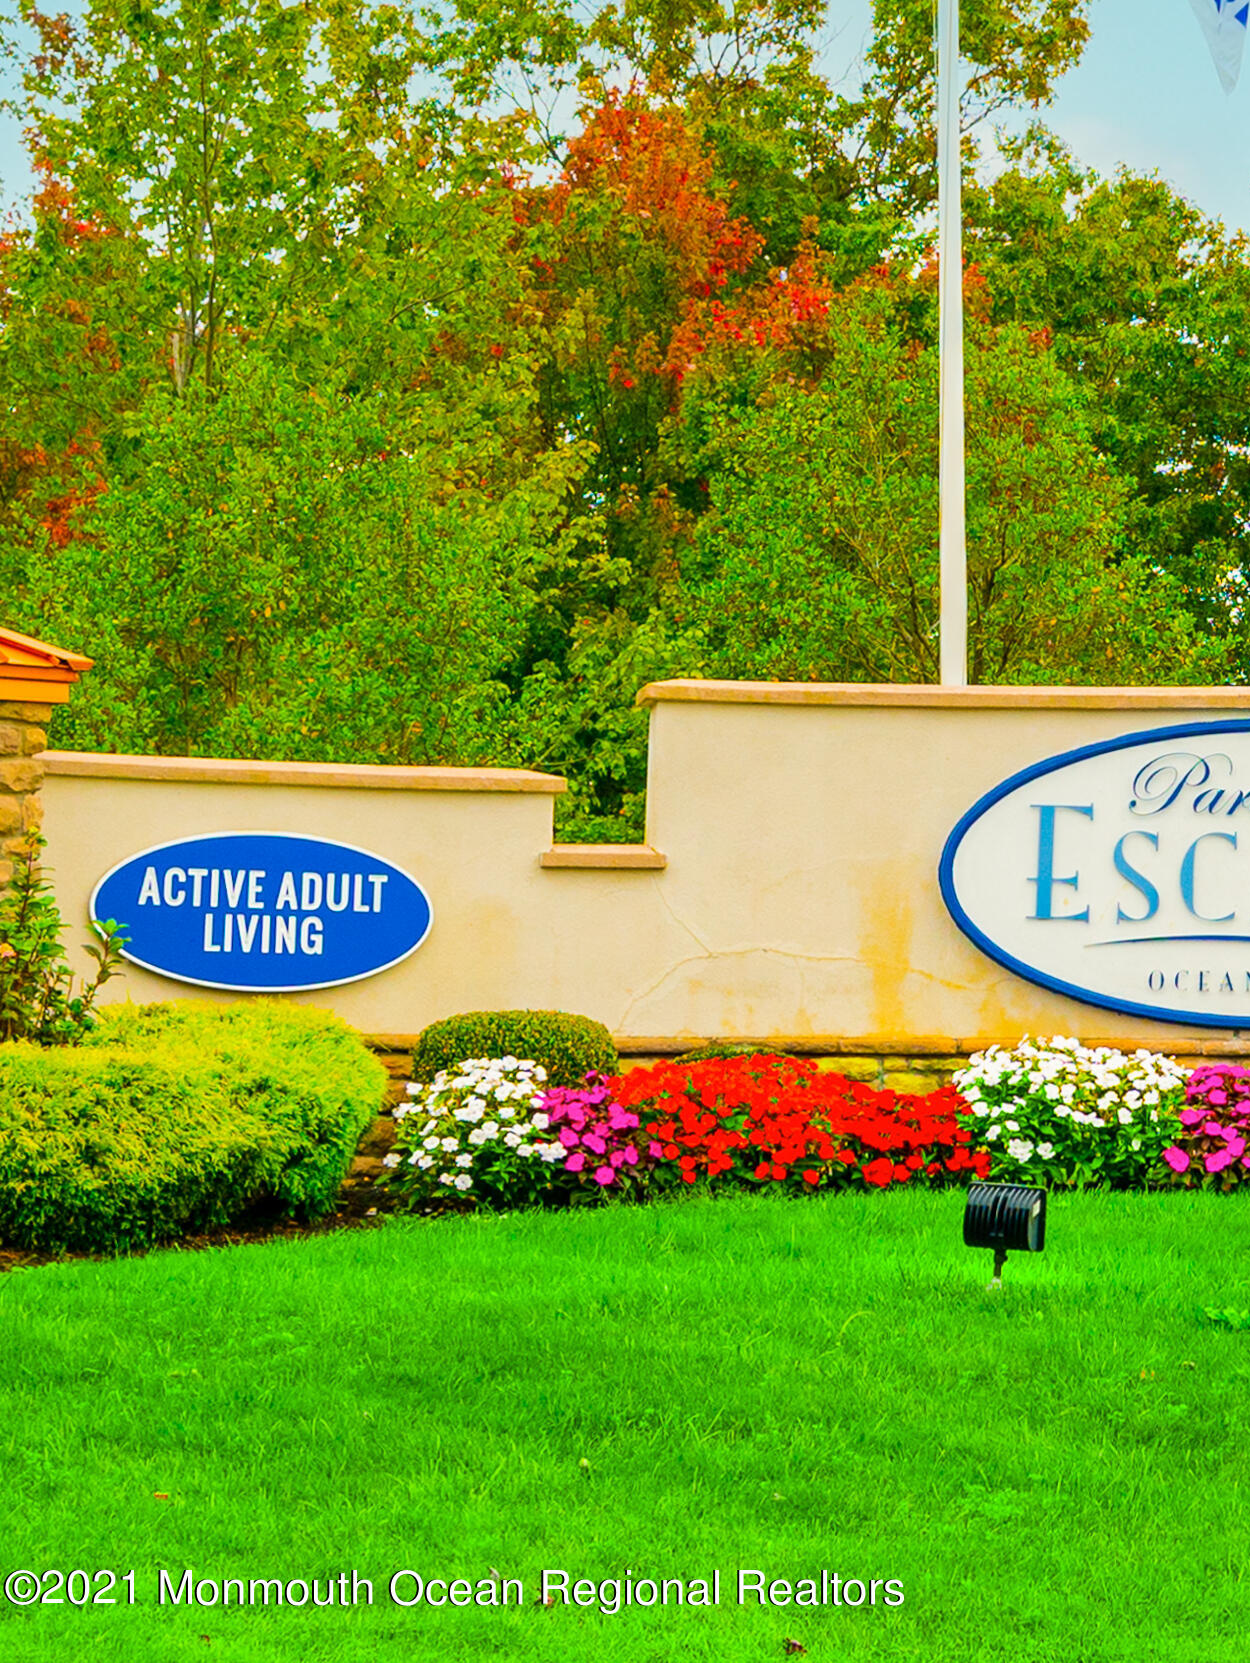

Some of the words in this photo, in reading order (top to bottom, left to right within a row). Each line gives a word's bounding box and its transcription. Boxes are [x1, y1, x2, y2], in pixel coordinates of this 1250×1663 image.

[138, 866, 265, 908] ACTIVE
[276, 871, 388, 913] ADULT
[203, 913, 324, 955] LIVING
